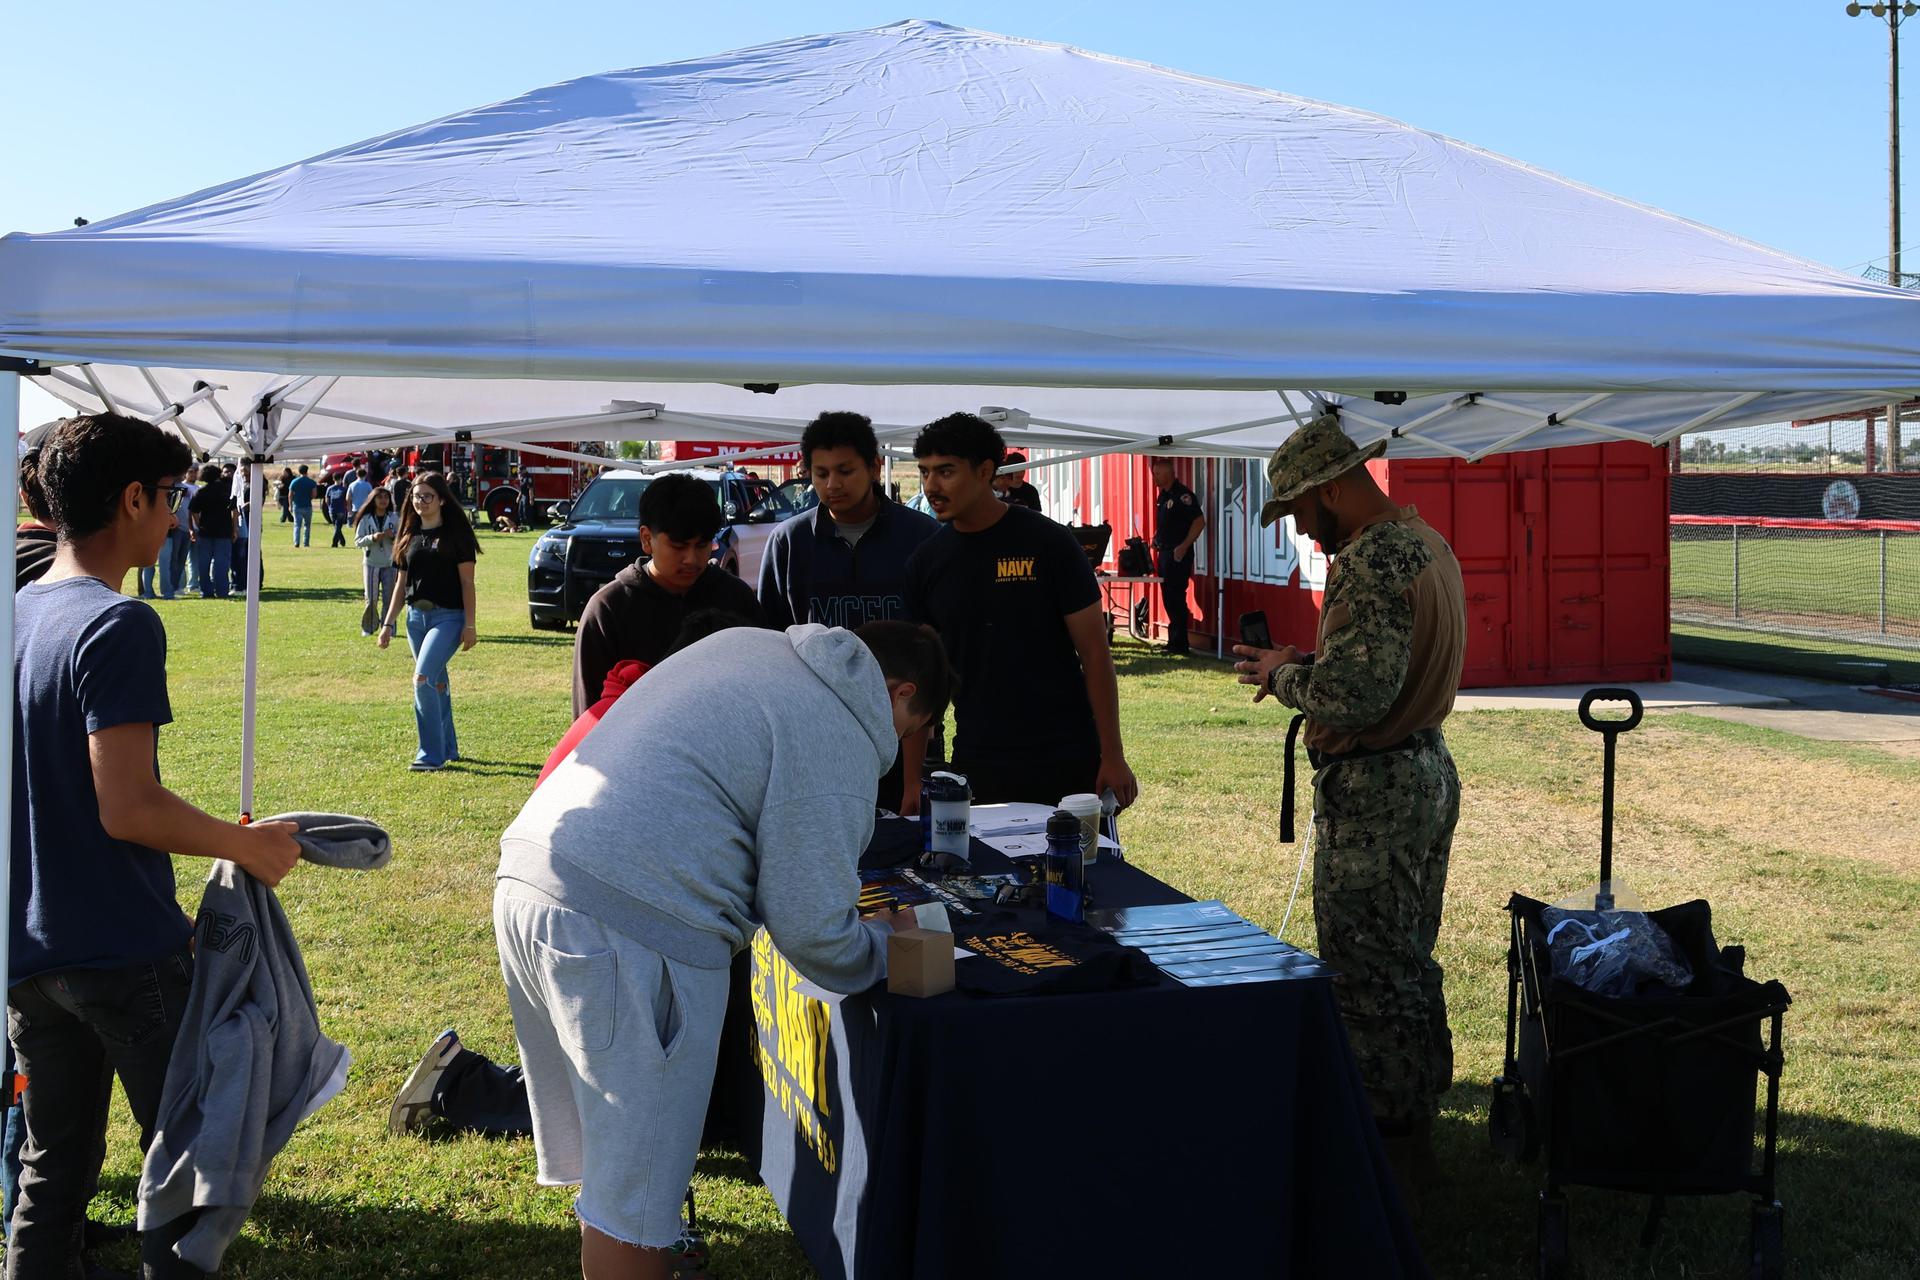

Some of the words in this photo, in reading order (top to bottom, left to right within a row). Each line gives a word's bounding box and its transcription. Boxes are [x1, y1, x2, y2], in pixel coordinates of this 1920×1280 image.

[997, 560, 1034, 578] NAVY
[773, 948, 831, 1117] NAVY
[780, 1075, 792, 1120] BY
[794, 1095, 814, 1150] THE
[816, 1122, 836, 1175] SEA
